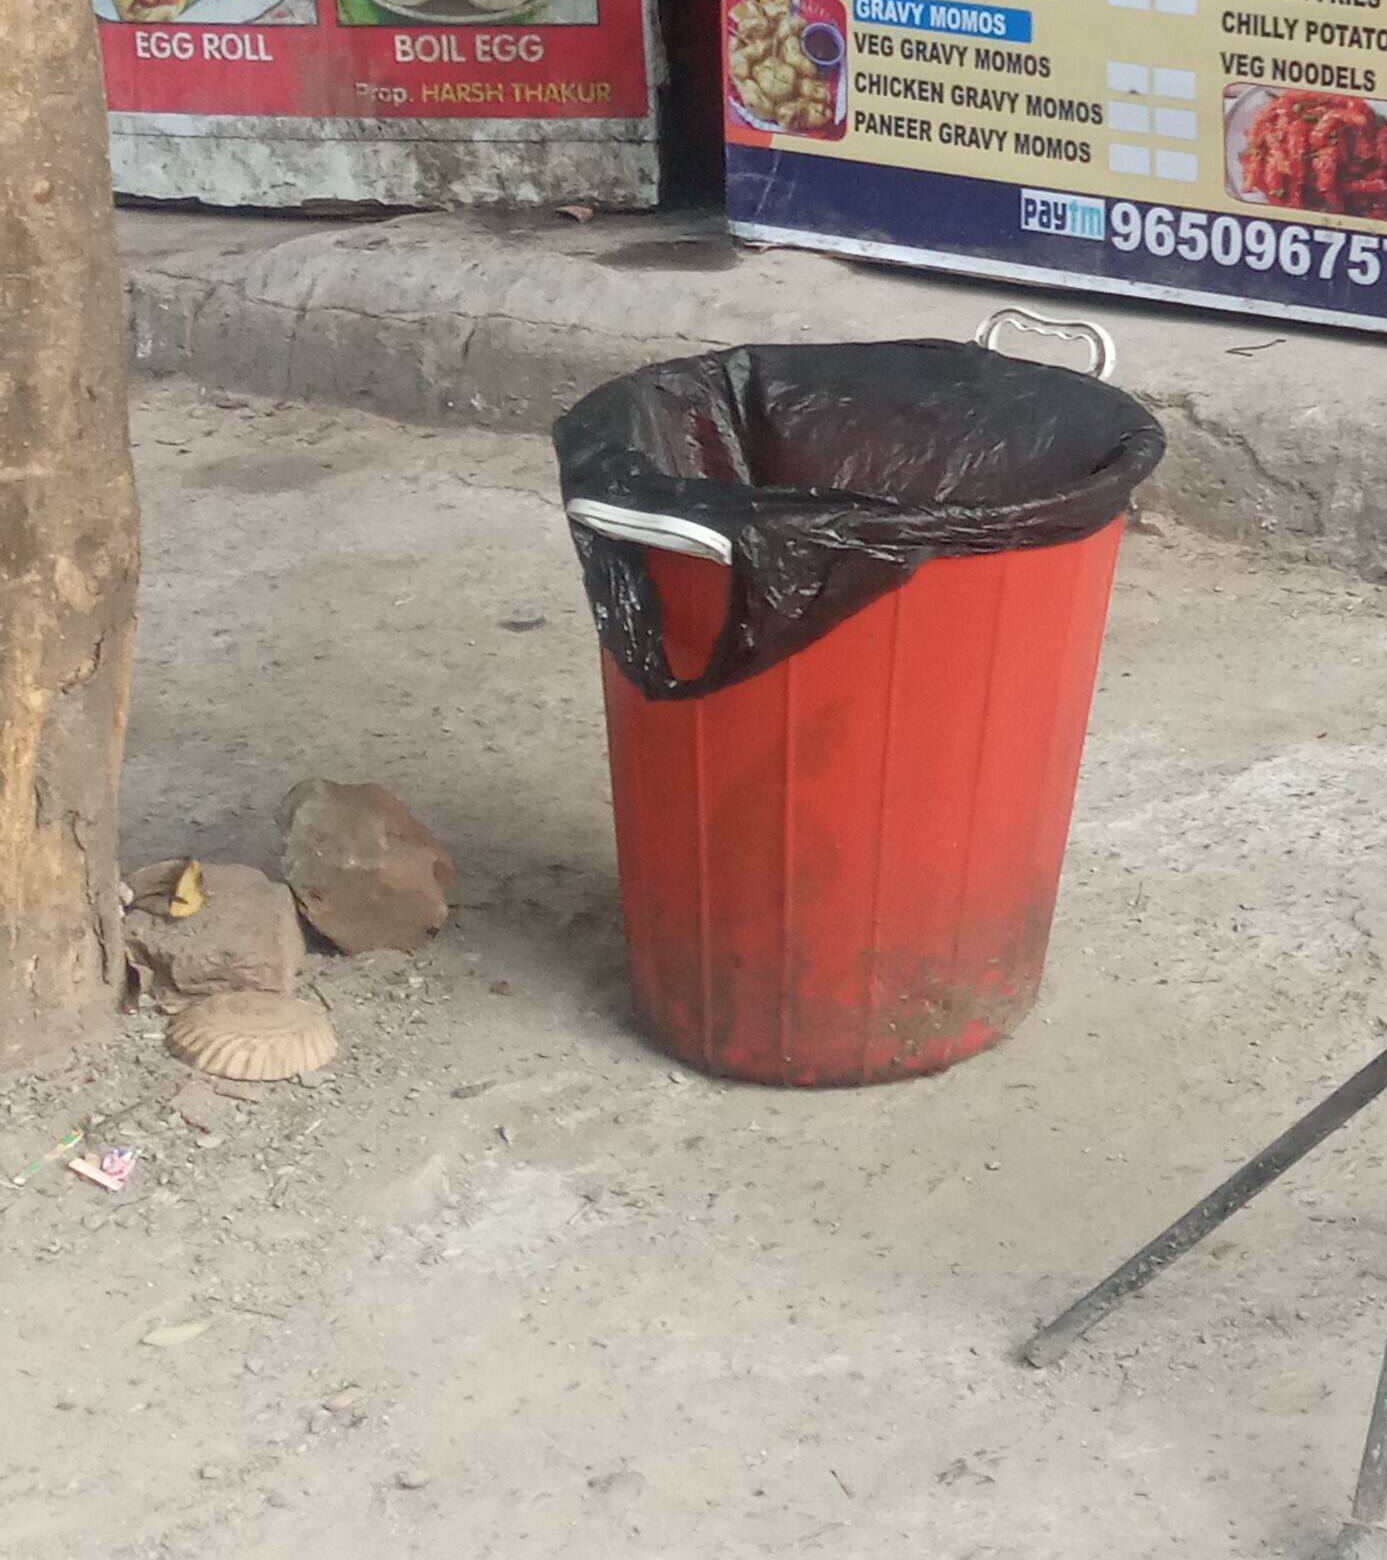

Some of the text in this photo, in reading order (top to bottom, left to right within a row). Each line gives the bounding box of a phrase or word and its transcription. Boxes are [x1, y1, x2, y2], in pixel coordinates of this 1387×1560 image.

[930, 6, 1006, 37] MOMOS
[1221, 10, 1299, 42] CHILLY
[135, 31, 273, 62] EGG ROLL
[394, 34, 544, 64] BOIL EGG
[853, 32, 1051, 78] VEG GRAVY MOMOS
[1220, 51, 1377, 92] VEG NOODELS
[356, 82, 613, 108] Prop. HARSH THAKUR
[854, 72, 1103, 126] CHICKEN GRAVY MOMOS
[853, 110, 1092, 163] PANEER GRAVY MOMOS
[1022, 196, 1103, 231] paytm
